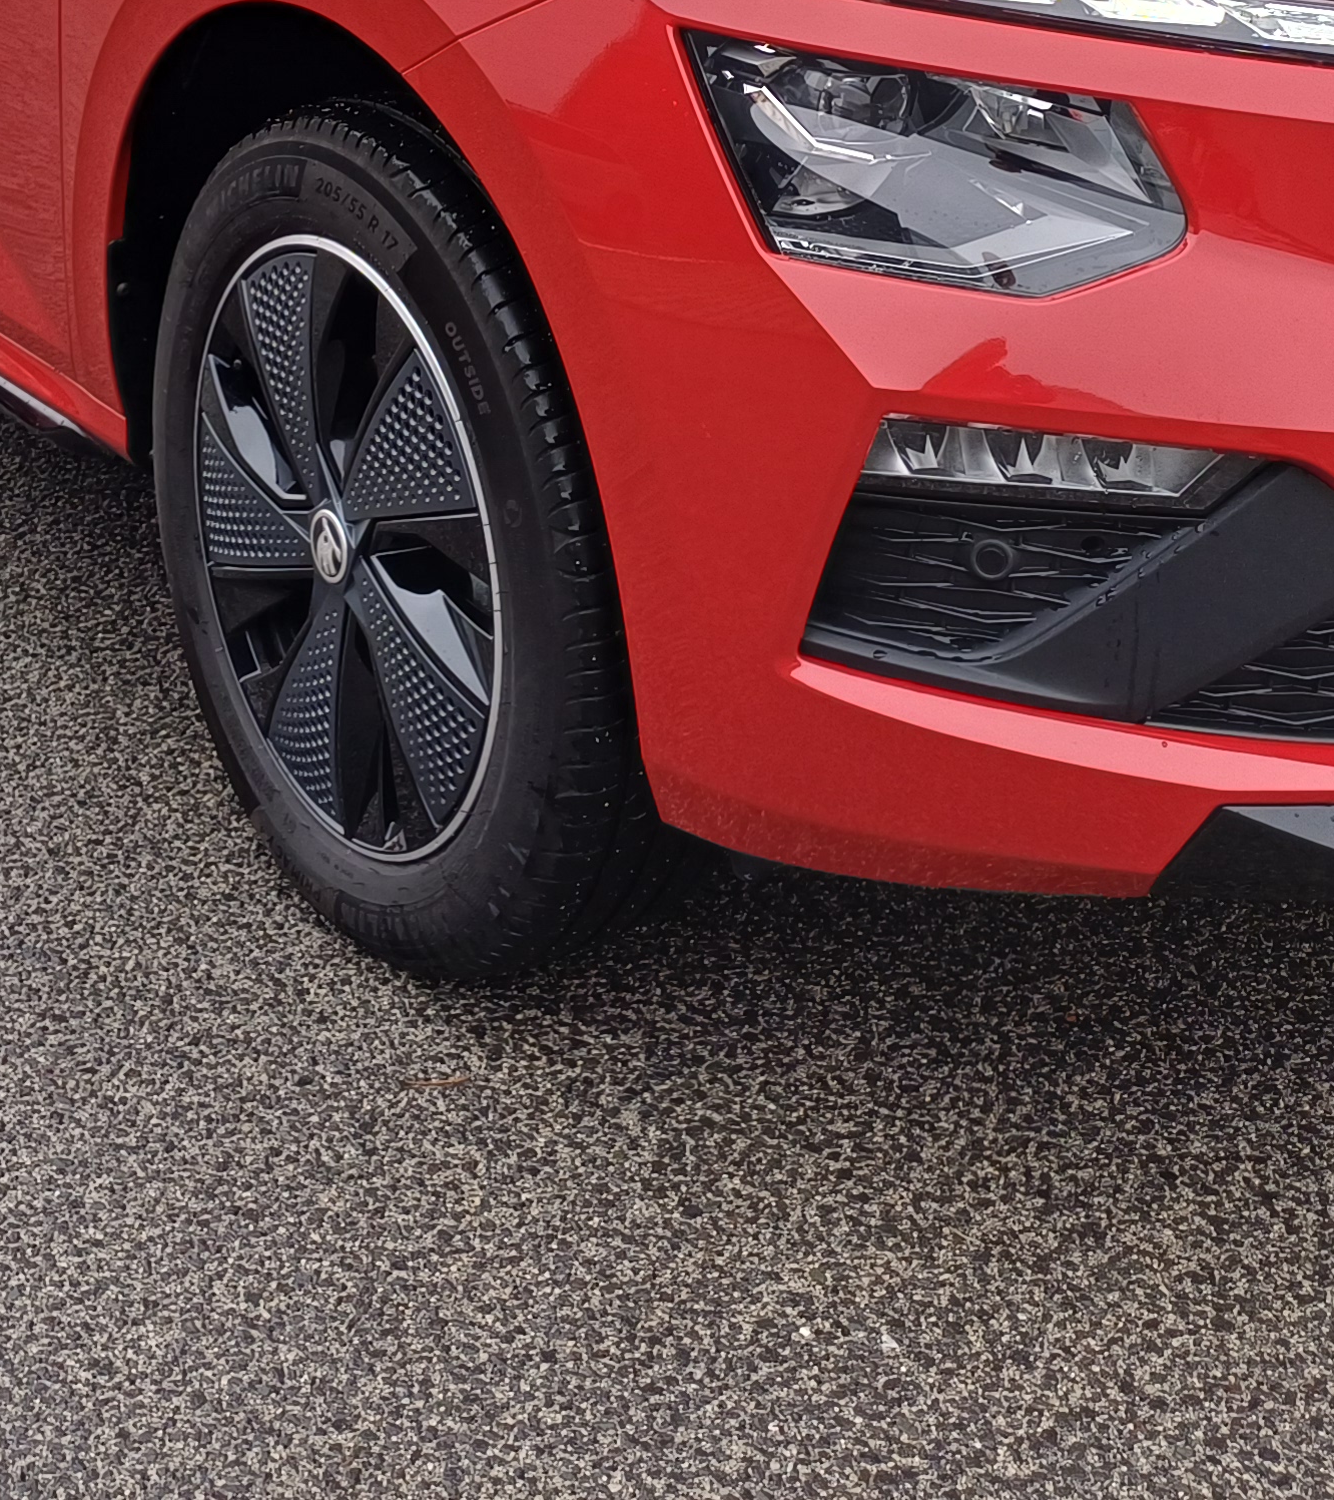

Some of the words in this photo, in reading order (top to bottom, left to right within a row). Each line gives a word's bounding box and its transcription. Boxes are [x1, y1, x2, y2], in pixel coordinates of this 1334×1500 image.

[315, 177, 367, 221] 205/55
[366, 217, 380, 234] R
[382, 230, 400, 251] 17
[444, 321, 492, 415] OUTSIDE
